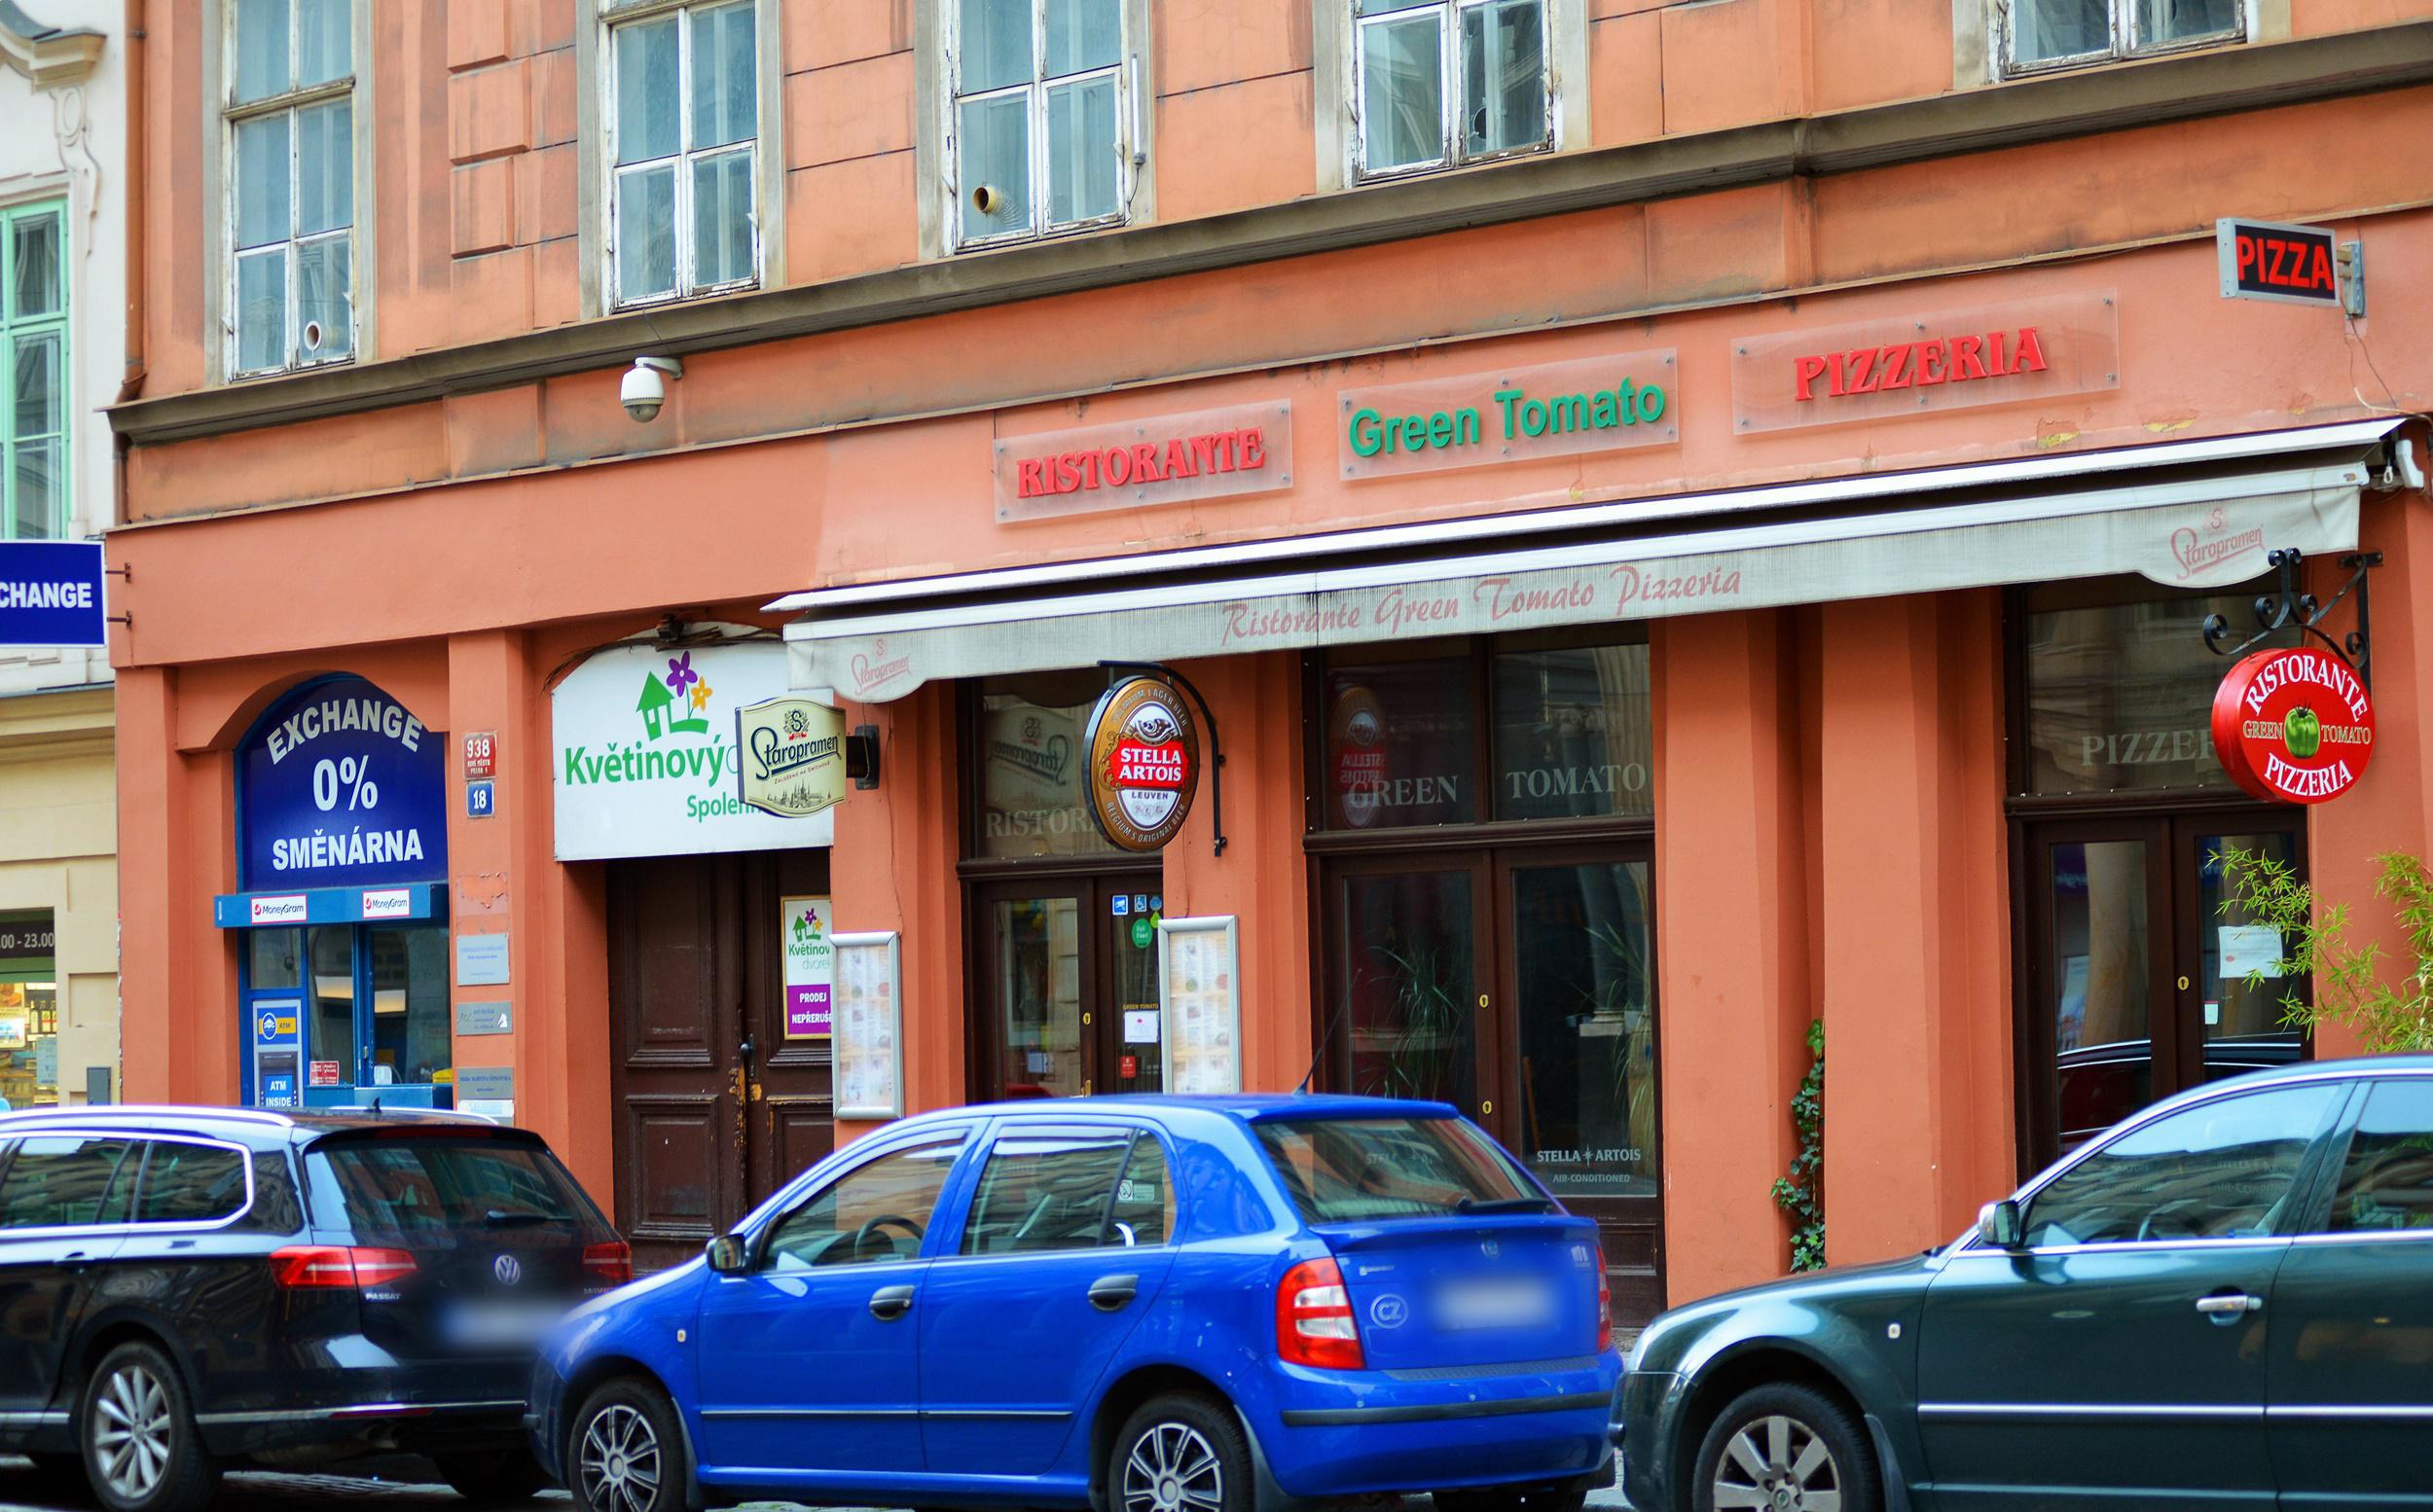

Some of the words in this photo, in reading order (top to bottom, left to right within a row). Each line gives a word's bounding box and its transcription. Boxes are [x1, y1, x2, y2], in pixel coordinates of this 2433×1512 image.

[2237, 234, 2335, 291] PIZZA
[1794, 326, 2048, 402] PIZZERIA
[1349, 405, 1480, 458] Green
[1494, 376, 1666, 439] Tomato
[1016, 426, 1267, 499] RISTORANTE
[2170, 526, 2264, 580] Staropramen
[0, 582, 92, 609] CHANGE
[1221, 602, 1361, 646] Ristorante
[1375, 589, 1459, 635] Green
[1473, 578, 1594, 621] Tomato
[1610, 565, 1740, 616] Pizzeria
[852, 653, 910, 696] Staropramen
[2245, 655, 2368, 723] RISTORANTE
[267, 699, 422, 765] EXCHANGE
[2242, 720, 2283, 740] GREEN
[2321, 724, 2372, 745] TOMATO
[467, 739, 490, 758] 938
[564, 735, 725, 787] Květinový
[750, 726, 840, 781] Staropramen
[1120, 747, 1182, 764] STELLA
[313, 755, 379, 811] 0%
[1118, 765, 1181, 781] ARTOIS
[1506, 763, 1646, 799] TOMATO
[2264, 752, 2353, 797] PIZZERIA
[473, 789, 487, 810] 18
[1131, 791, 1169, 800] LEUVEN
[1348, 775, 1459, 809] GREEN
[986, 808, 1094, 838] RISTOR
[272, 826, 423, 871] SMĚNÁRNA
[262, 904, 305, 916] MoneyGram
[372, 897, 408, 908] MoneyGram
[24, 932, 54, 948] 23.00
[788, 942, 830, 956] Květinov
[802, 959, 830, 971] dvore
[799, 992, 826, 1004] PRODEJ
[271, 1081, 286, 1091] ATM
[266, 1097, 292, 1107] INSIDE
[1537, 1149, 1581, 1163] STELLA
[1595, 1148, 1641, 1161] ARTOIS
[1552, 1173, 1630, 1183] AIR-CONDITIONED
[365, 1292, 401, 1301] PASSAT
